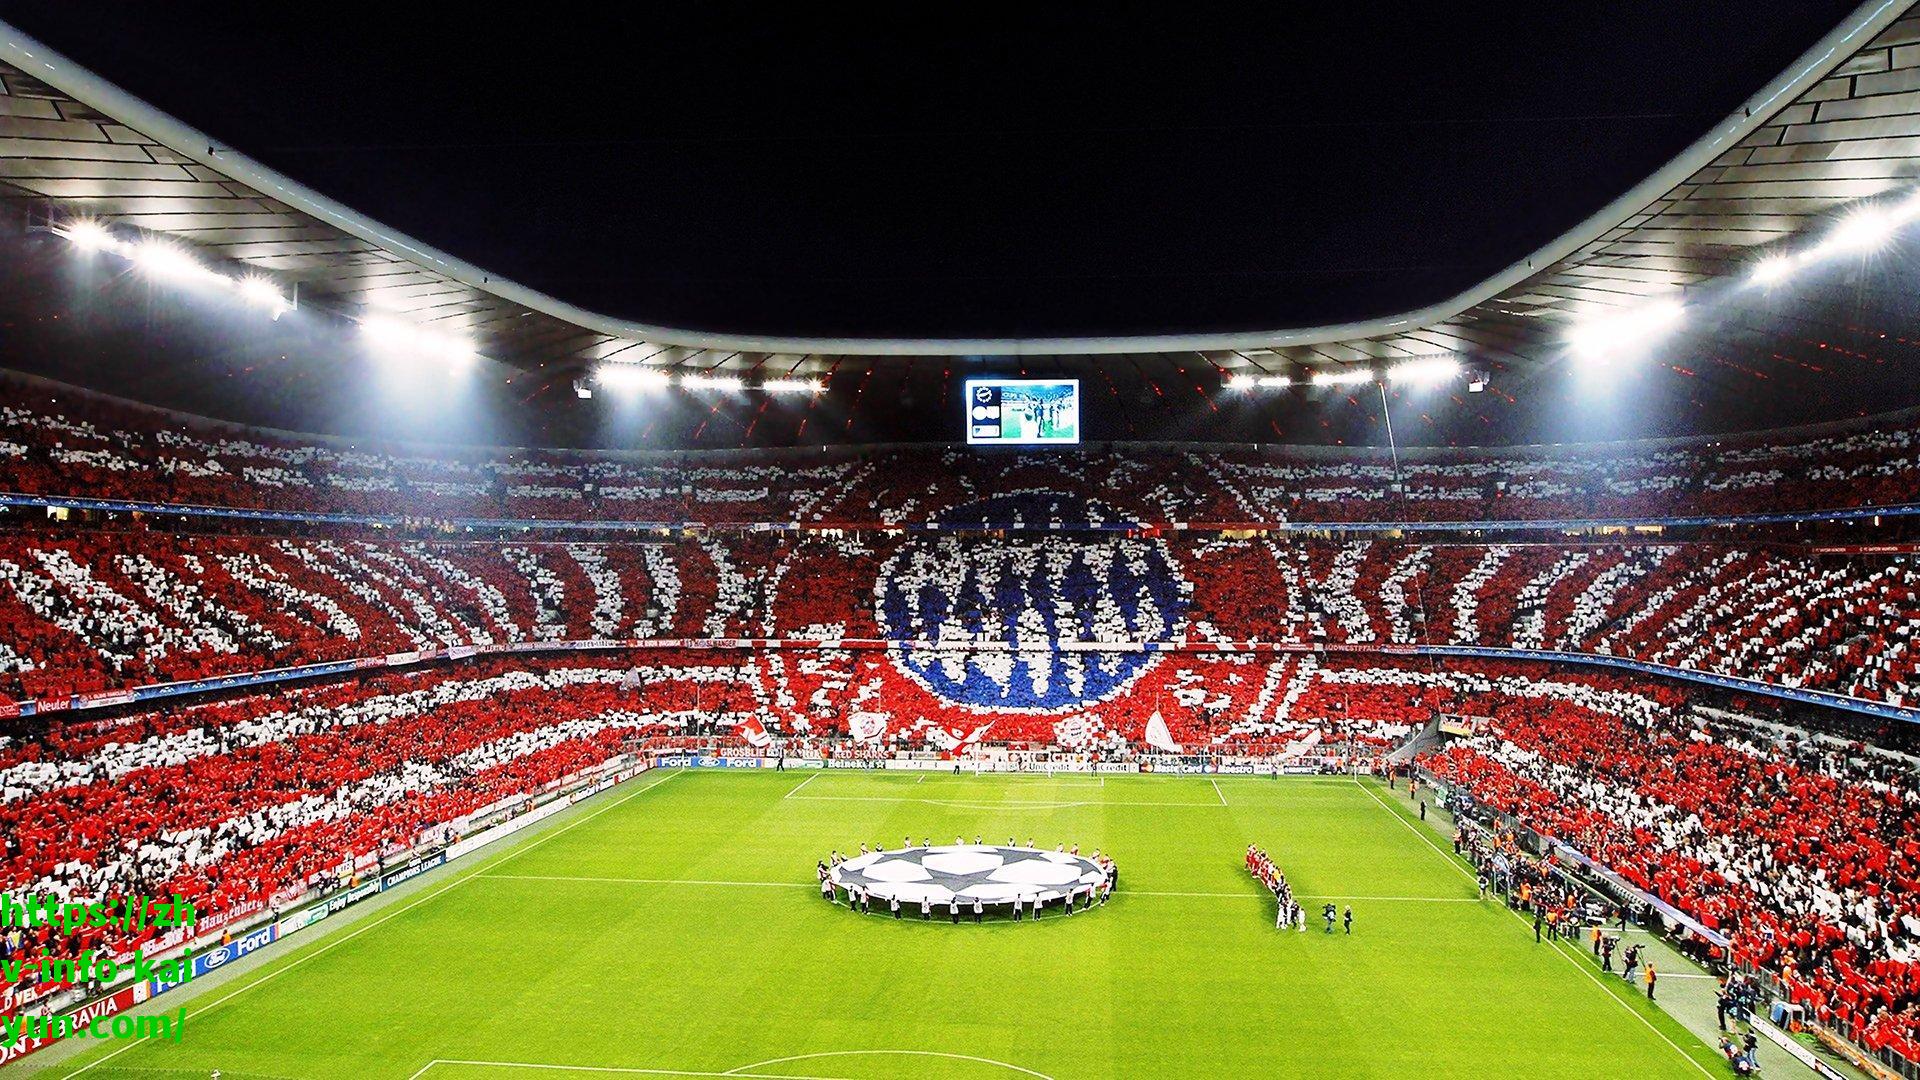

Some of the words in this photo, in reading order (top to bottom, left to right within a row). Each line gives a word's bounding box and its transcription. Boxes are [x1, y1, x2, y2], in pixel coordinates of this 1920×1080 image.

[37, 699, 70, 713] Neuler
[855, 750, 889, 759] SHARKS
[662, 757, 691, 767] Ford
[726, 758, 757, 768] Ford
[828, 760, 875, 769] Heinekn
[1154, 764, 1203, 774] MasteCard
[1218, 764, 1253, 774] Maestro
[387, 864, 420, 887] CHAMPIONS
[421, 855, 442, 873] LEAGUE
[330, 897, 347, 911] Enjoy
[237, 925, 271, 957] Ford
